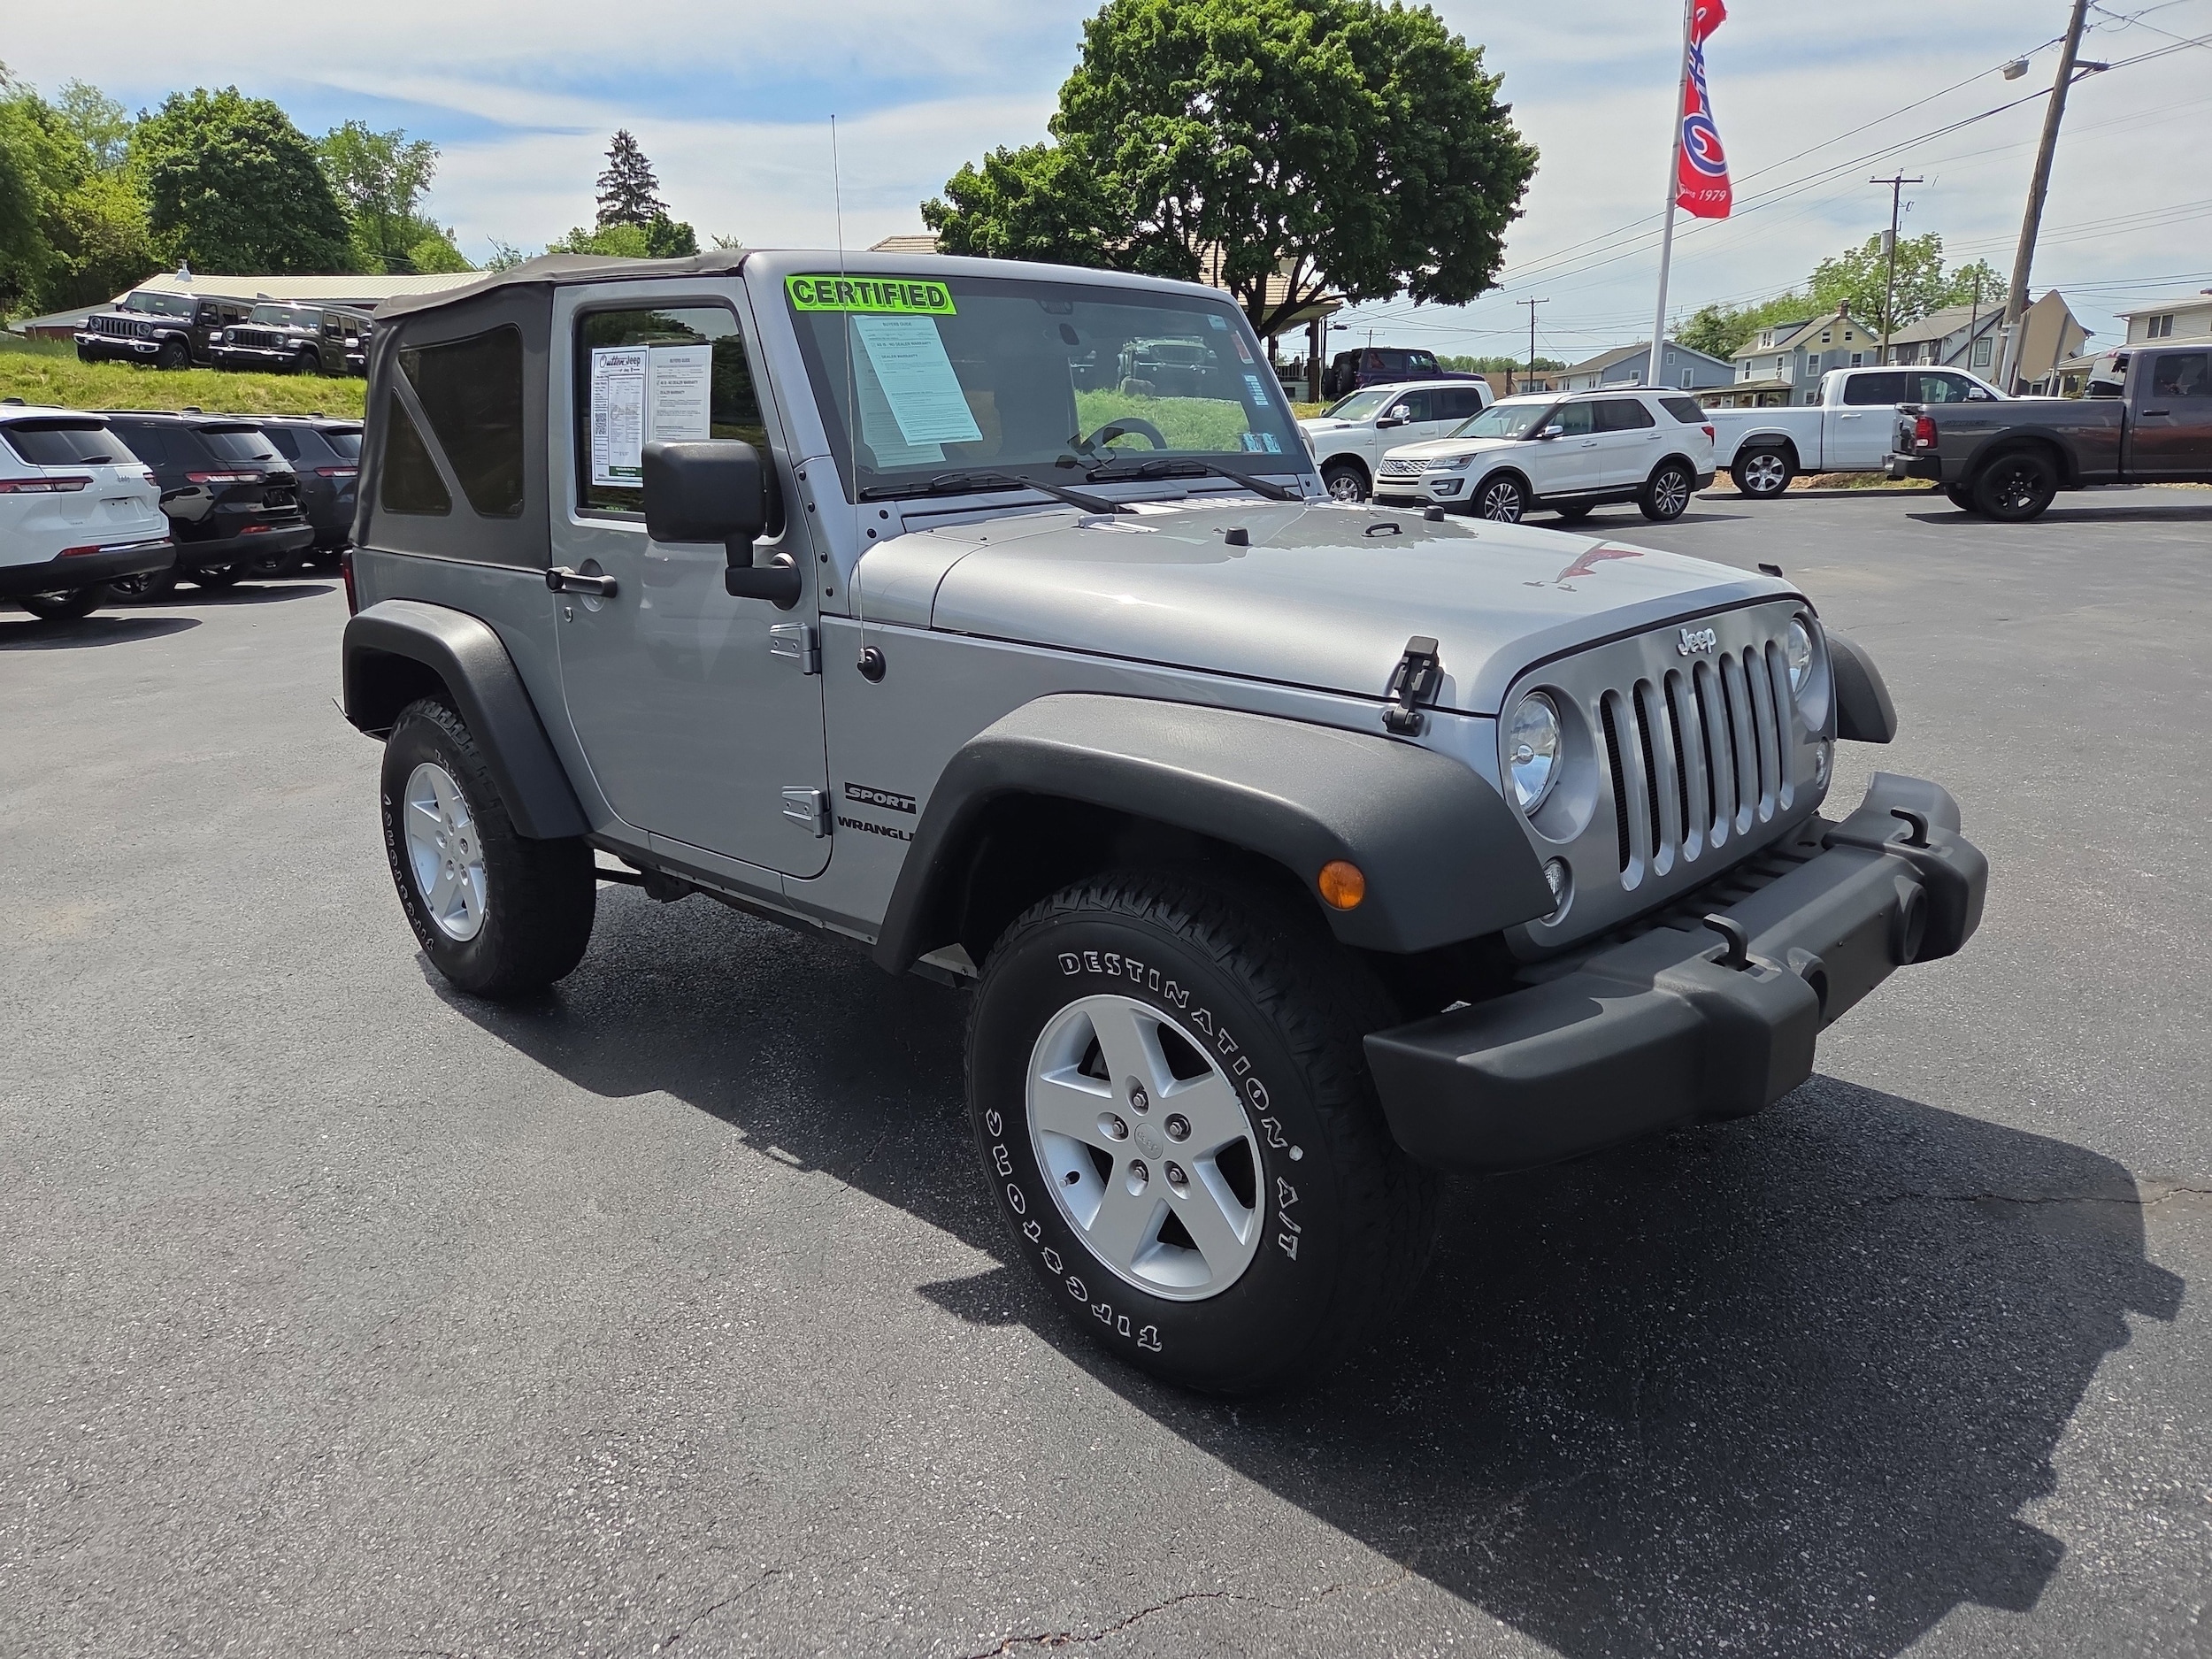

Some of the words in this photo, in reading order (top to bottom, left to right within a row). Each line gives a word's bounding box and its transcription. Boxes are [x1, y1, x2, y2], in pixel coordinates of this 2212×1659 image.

[1699, 188, 1727, 202] 1979
[792, 279, 950, 310] CERTIFIED
[600, 355, 626, 368] Outten
[626, 354, 641, 366] Jeep
[1678, 628, 1717, 657] Jeep
[849, 787, 916, 810] SPORT
[1058, 950, 1289, 1149] DESTINATION
[1277, 1176, 1302, 1261] A/T
